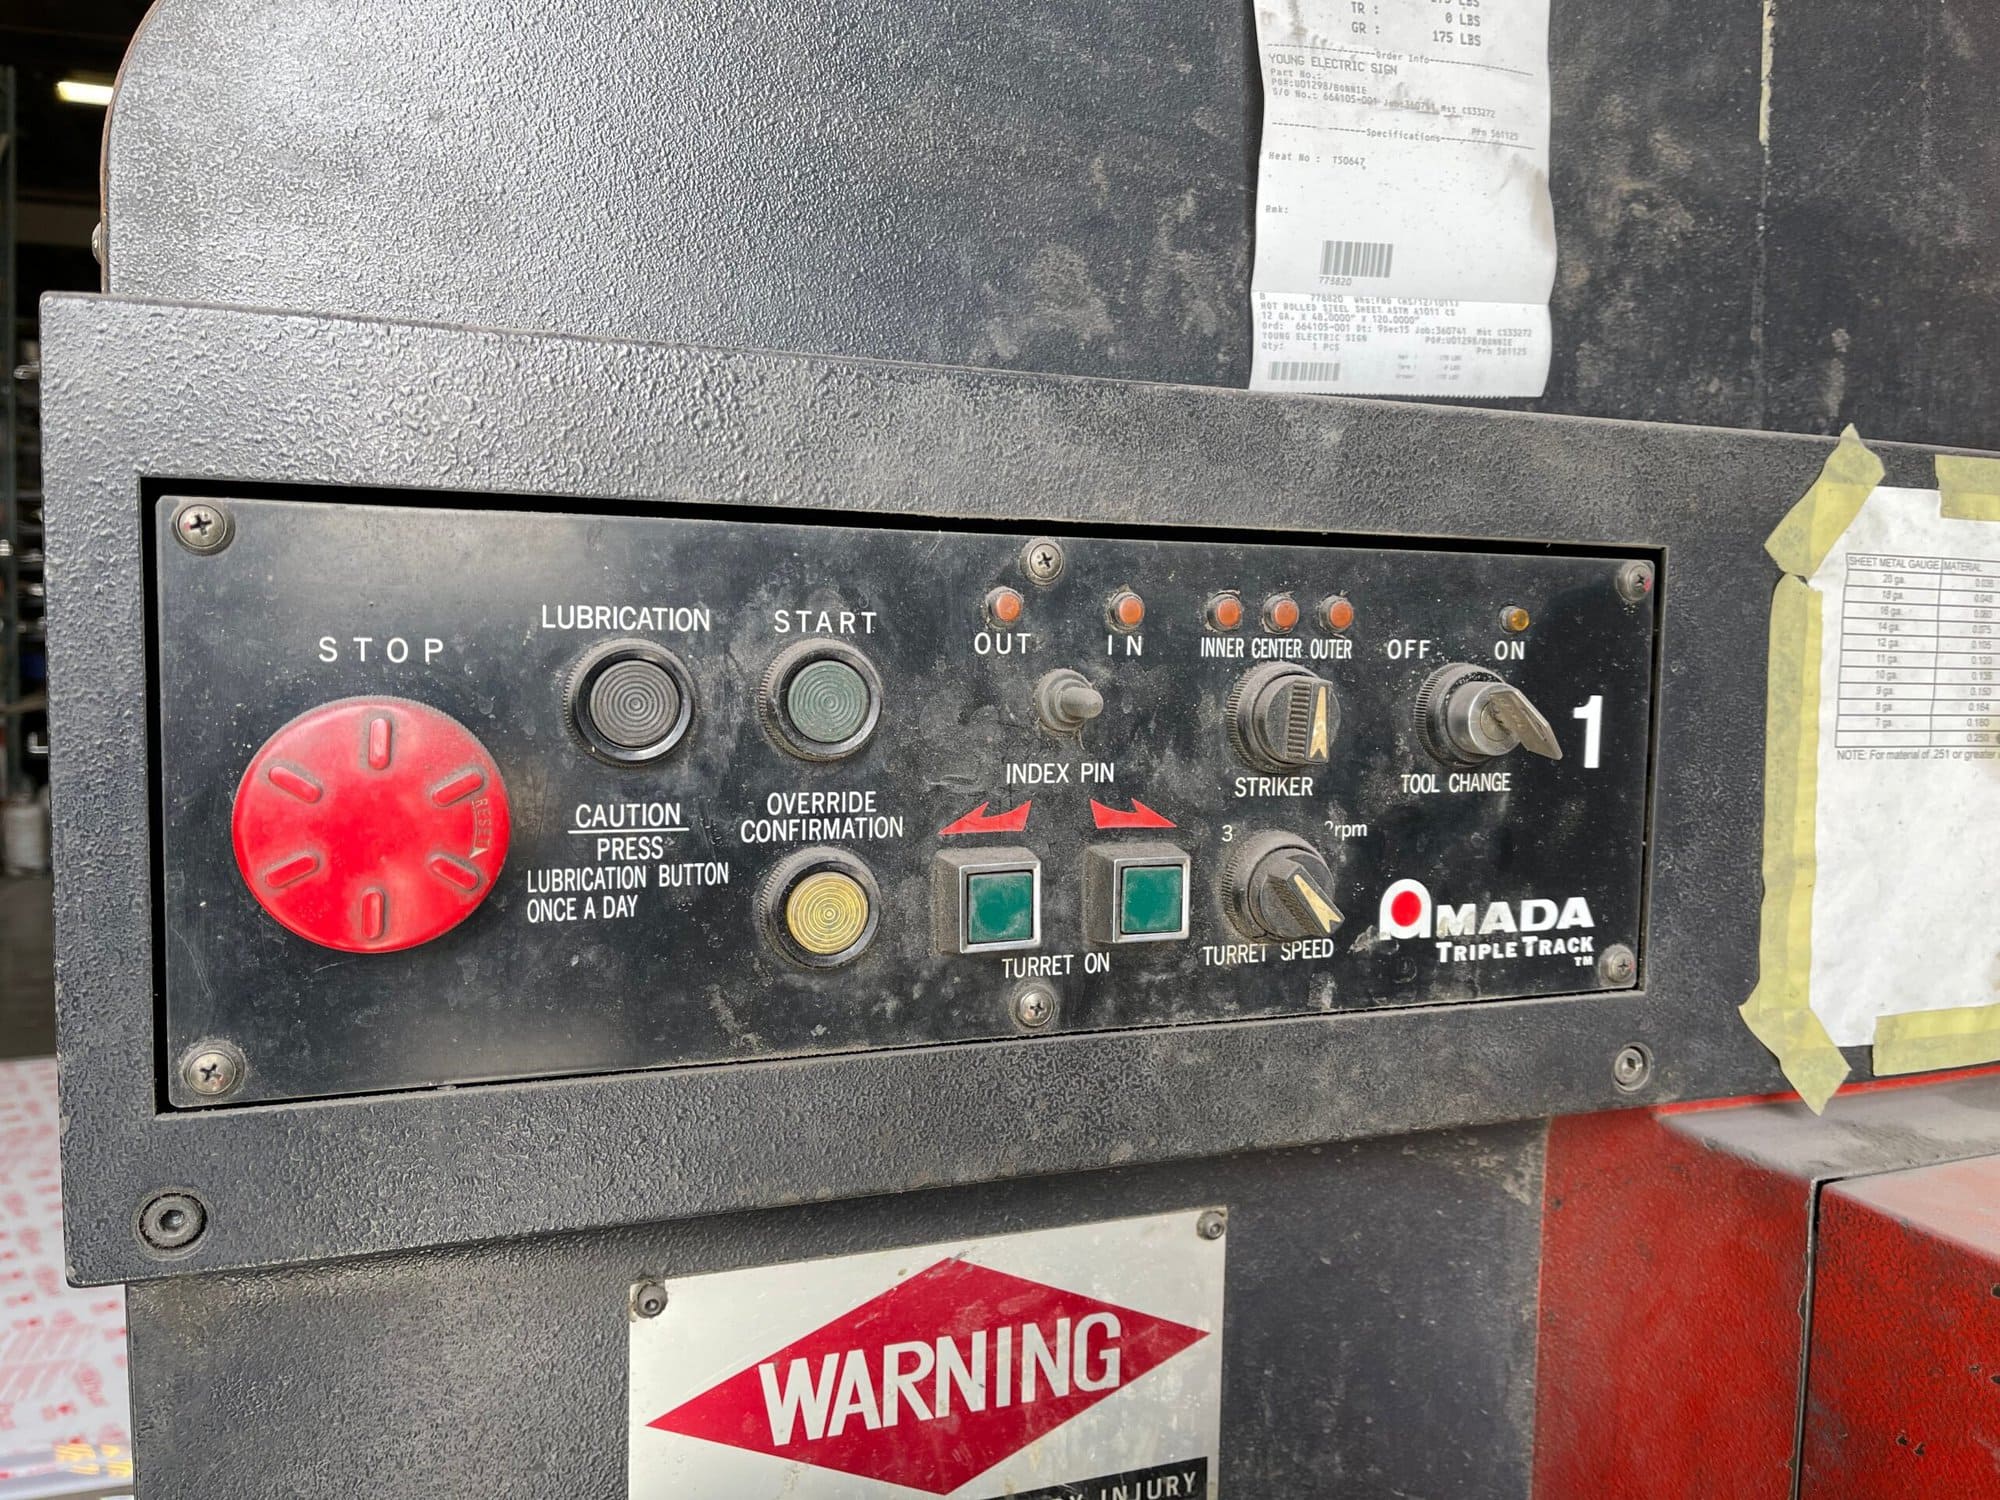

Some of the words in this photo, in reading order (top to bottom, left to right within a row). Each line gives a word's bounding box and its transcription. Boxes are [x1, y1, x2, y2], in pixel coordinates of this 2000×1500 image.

[1351, 2, 1366, 14] TR
[1351, 21, 1367, 34] GR
[1459, 13, 1481, 27] LBS
[1433, 30, 1454, 43] 175
[1460, 33, 1482, 46] LBS
[1268, 54, 1305, 66] YOUNG
[1311, 56, 1366, 72] ELECTRIC
[1371, 62, 1398, 75] SIGN
[1366, 128, 1441, 143] Specifications
[1268, 151, 1292, 160] Heat
[1260, 302, 1278, 311] HOT
[1283, 302, 1317, 312] ROLLED
[1323, 304, 1350, 313] STEEL
[1355, 305, 1382, 313] SHEET
[1263, 331, 1290, 341] YOUNG
[1295, 332, 1340, 342] ELECTRIC
[1345, 333, 1368, 342] SIGN
[1850, 556, 1877, 567] SHEET
[1879, 557, 1906, 569] METAL
[1908, 559, 1940, 570] GAUGE
[541, 604, 711, 634] LUBRICATION
[774, 609, 877, 634] START
[318, 636, 443, 665] STOP
[973, 632, 1031, 655] OUT
[1107, 635, 1143, 656] IN
[1200, 637, 1245, 659] INNER
[1251, 637, 1302, 660] CENTER
[1310, 638, 1353, 660] OUTER
[1387, 640, 1431, 660] OFF
[1494, 640, 1526, 660] ON
[1573, 695, 1603, 769] 1
[1837, 750, 1867, 761] NOTE:
[1005, 763, 1074, 785] INDEX
[1080, 763, 1115, 784] PIN
[1401, 774, 1441, 794] TOOL
[1448, 773, 1511, 793] CHANGE
[1234, 776, 1314, 799] STRIKER
[766, 791, 877, 815] OVERRIDE
[574, 802, 682, 828] CAUTION
[740, 817, 904, 844] CONFIRMATION
[1221, 824, 1234, 843] 3
[596, 835, 664, 861] PRESS
[526, 866, 646, 894] LUBRICATION
[657, 861, 729, 888] BUTTON
[526, 898, 579, 925] ONCE
[583, 898, 597, 920] A
[601, 895, 638, 919] DAY
[1379, 878, 1596, 941] AMADA
[1203, 944, 1268, 967] TURRET
[1280, 937, 1334, 961] SPEED
[1435, 941, 1518, 964] TRIPLE
[1521, 934, 1595, 958] TRACK
[1001, 956, 1079, 980] TURRET
[1084, 953, 1111, 976] ON
[1573, 955, 1594, 967] TM
[758, 1311, 1123, 1448] WARNING
[1100, 1471, 1197, 1500] INJURY
